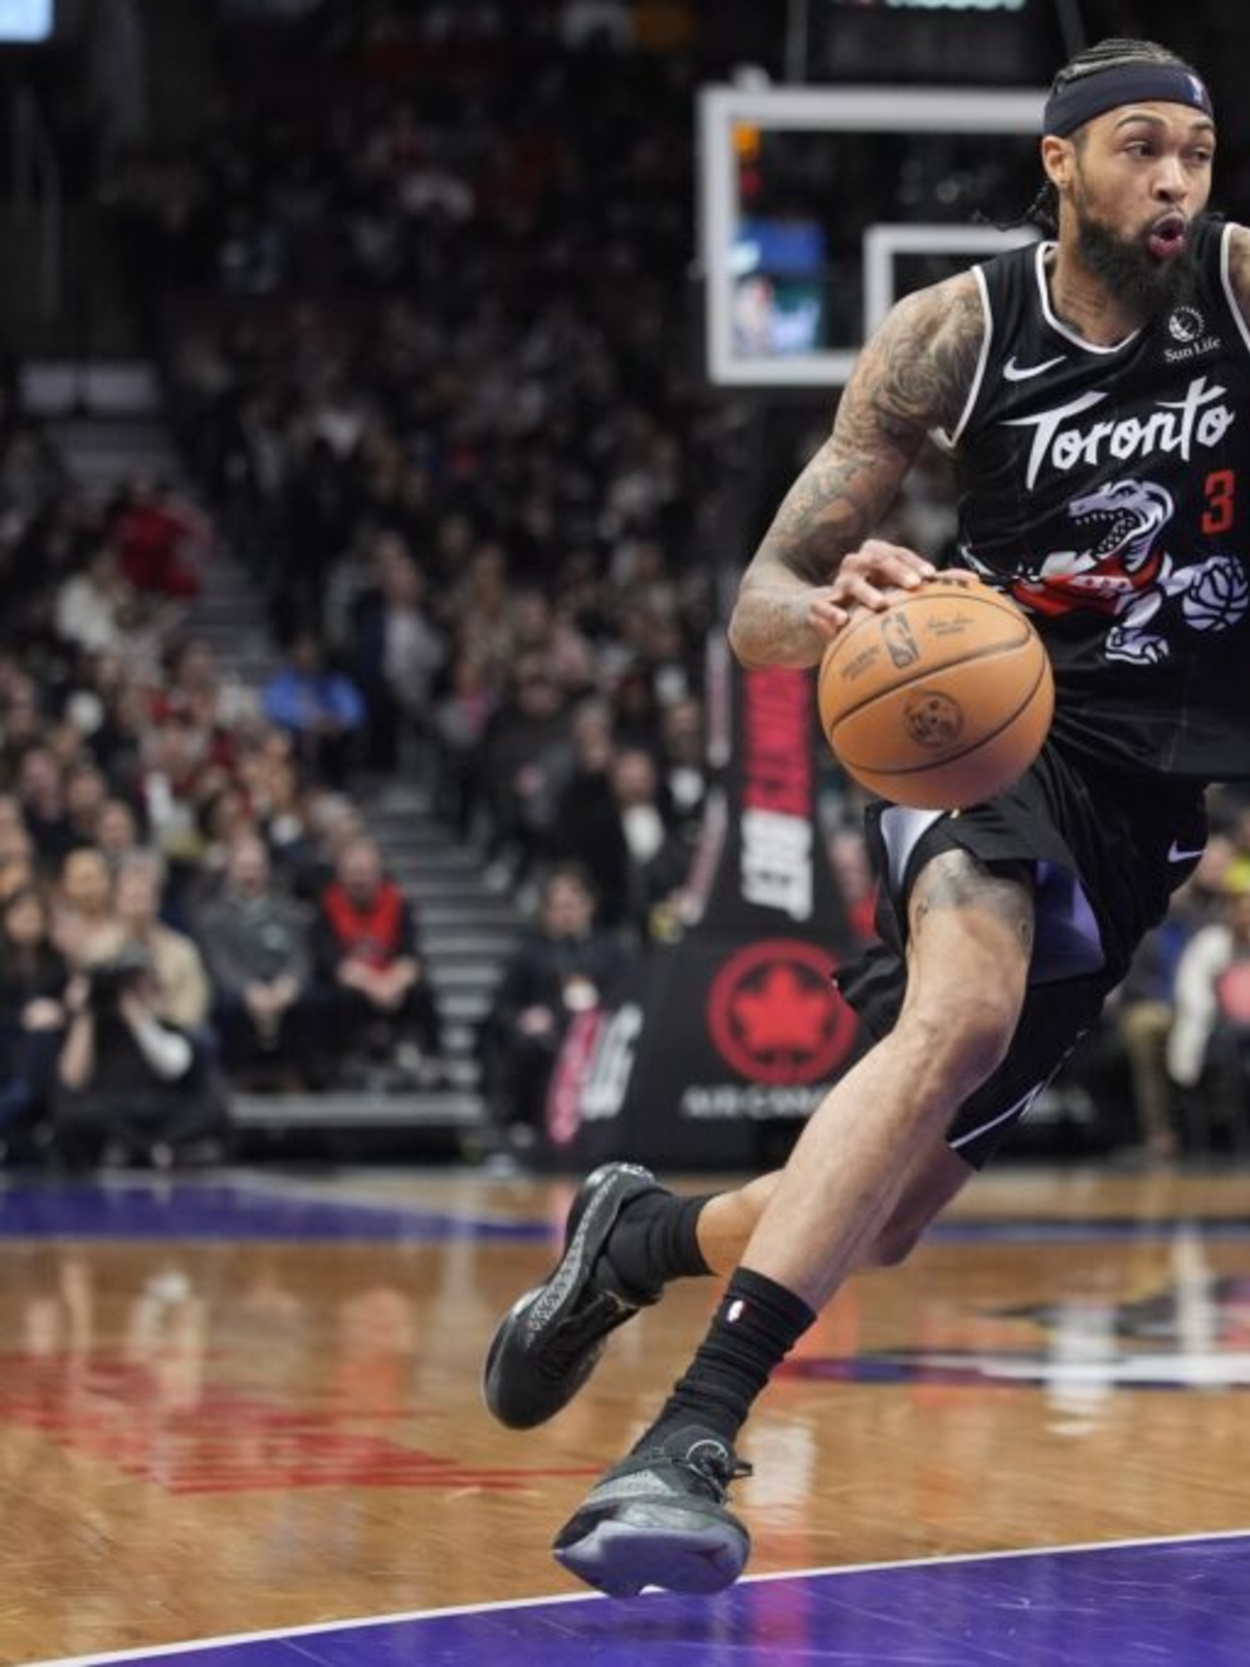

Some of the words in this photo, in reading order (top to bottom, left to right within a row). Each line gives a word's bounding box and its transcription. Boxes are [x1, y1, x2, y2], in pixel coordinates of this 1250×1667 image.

[1164, 347, 1193, 362] Sun
[1193, 336, 1221, 355] Life
[1001, 376, 1236, 491] Toronto
[1201, 469, 1236, 535] 3
